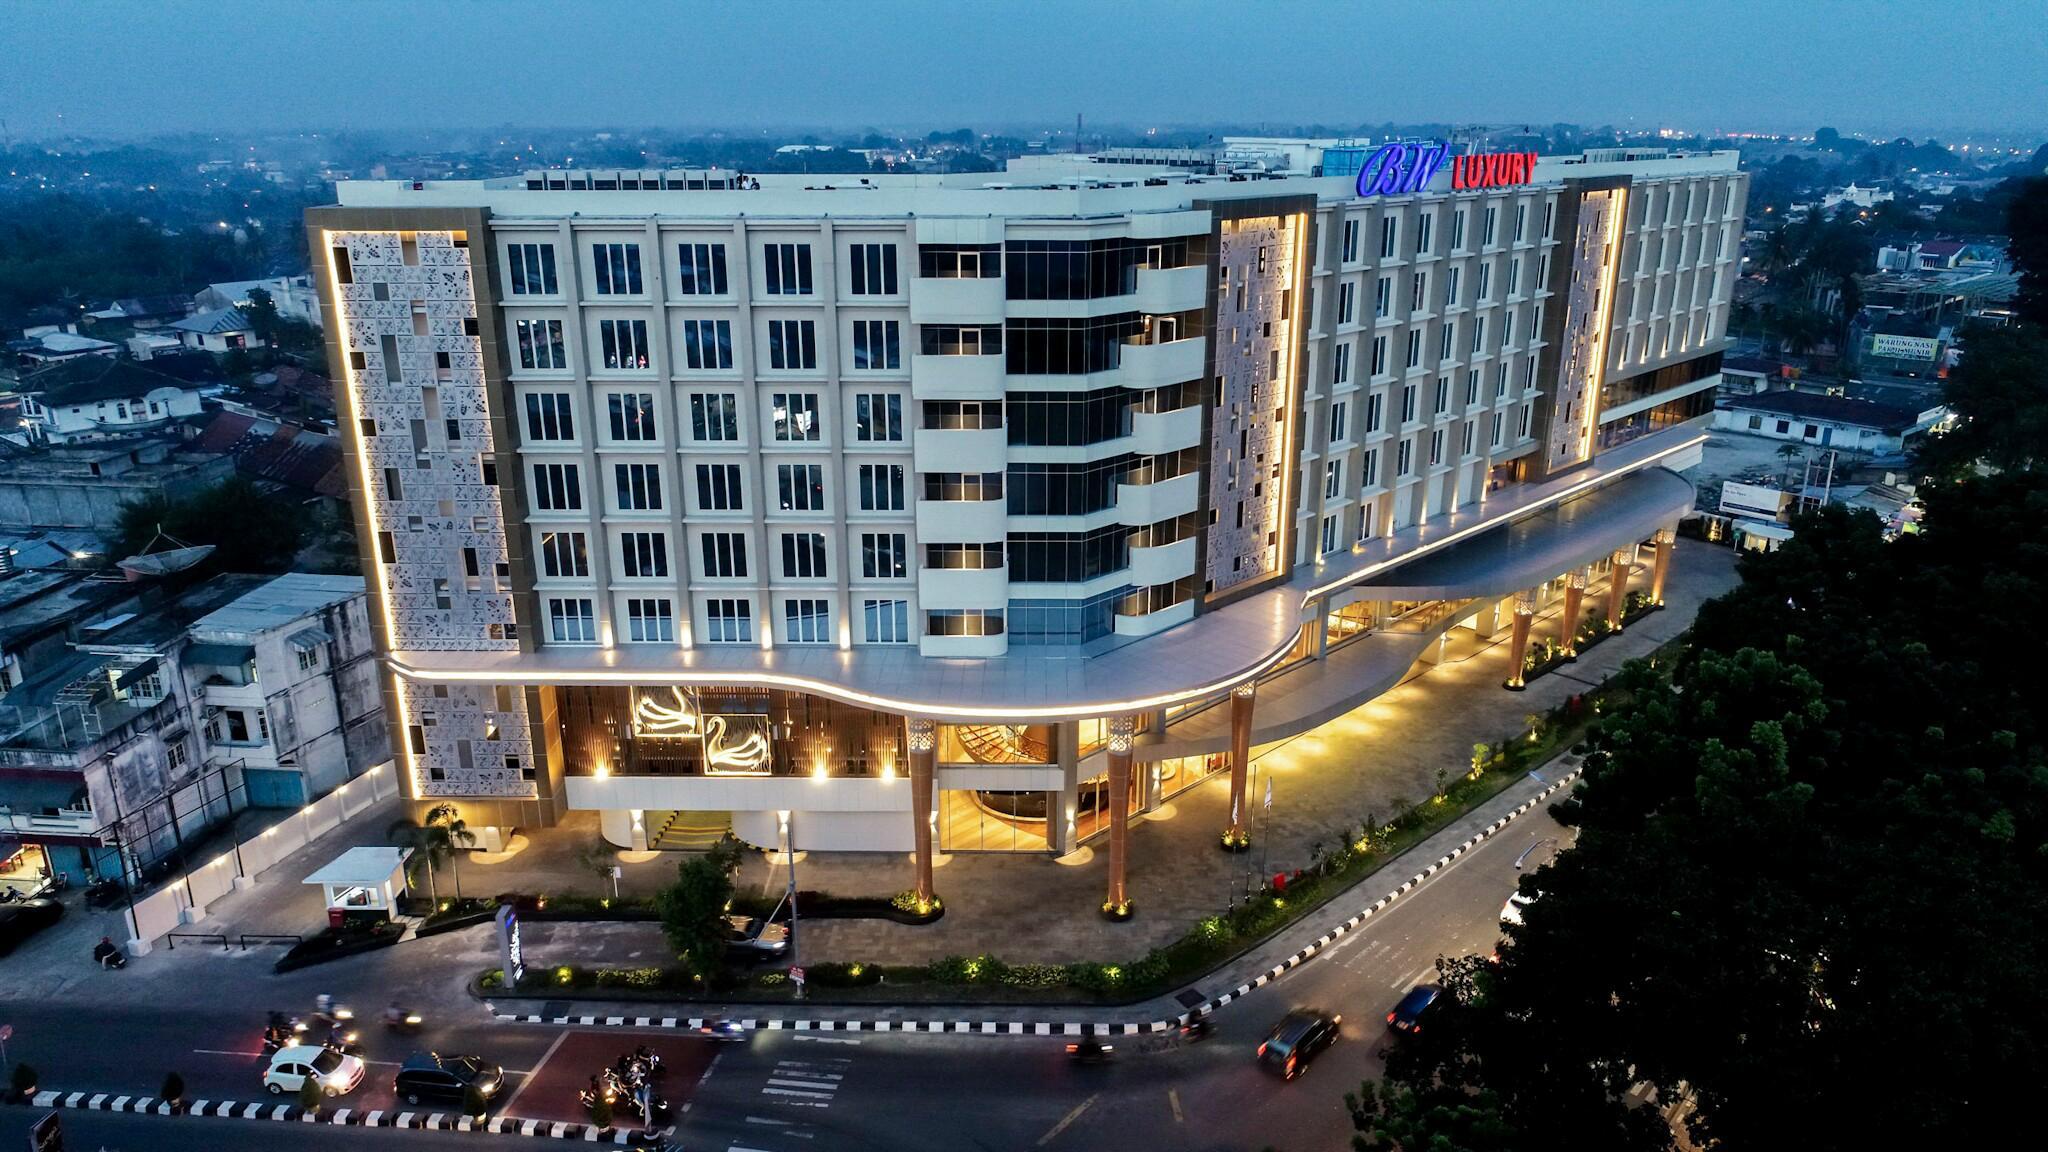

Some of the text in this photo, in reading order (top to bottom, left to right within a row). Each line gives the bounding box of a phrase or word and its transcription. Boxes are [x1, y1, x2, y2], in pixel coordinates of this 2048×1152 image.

[1357, 141, 1538, 197] BW LUXURY
[1878, 338, 1934, 349] WARUNG NASI
